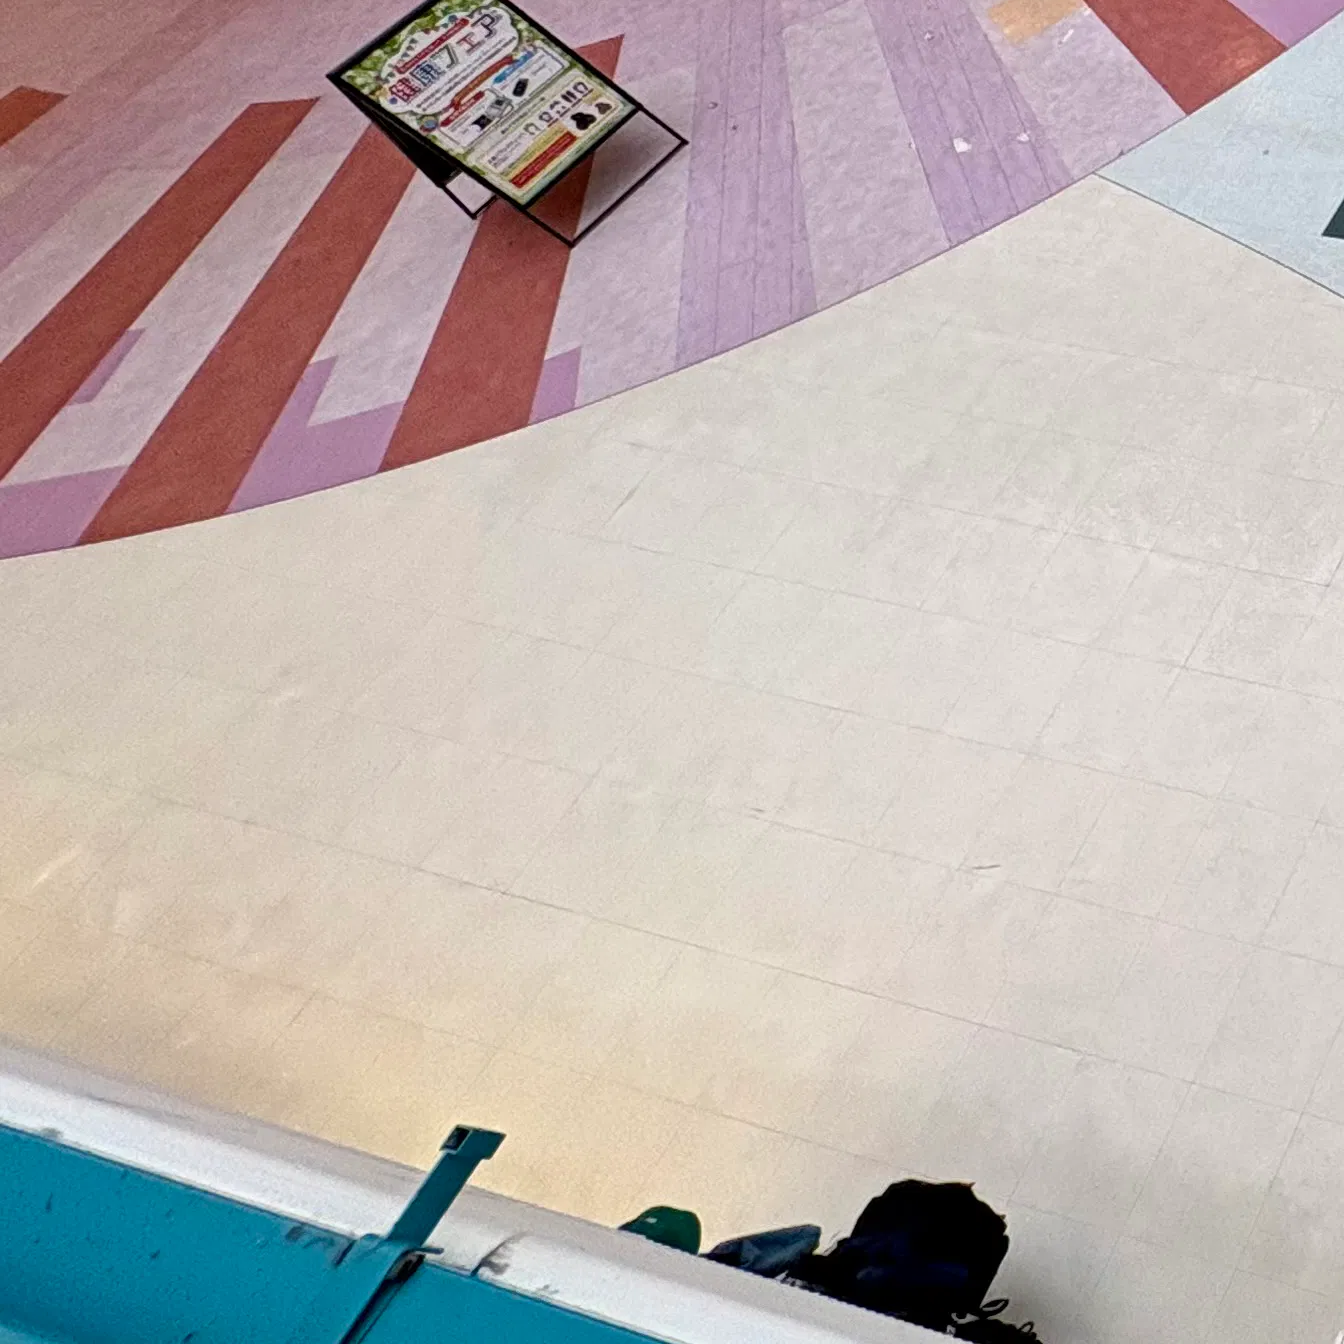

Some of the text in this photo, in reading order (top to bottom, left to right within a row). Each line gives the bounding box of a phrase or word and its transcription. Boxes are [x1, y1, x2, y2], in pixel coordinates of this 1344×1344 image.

[389, 13, 500, 103] 健康フェア
